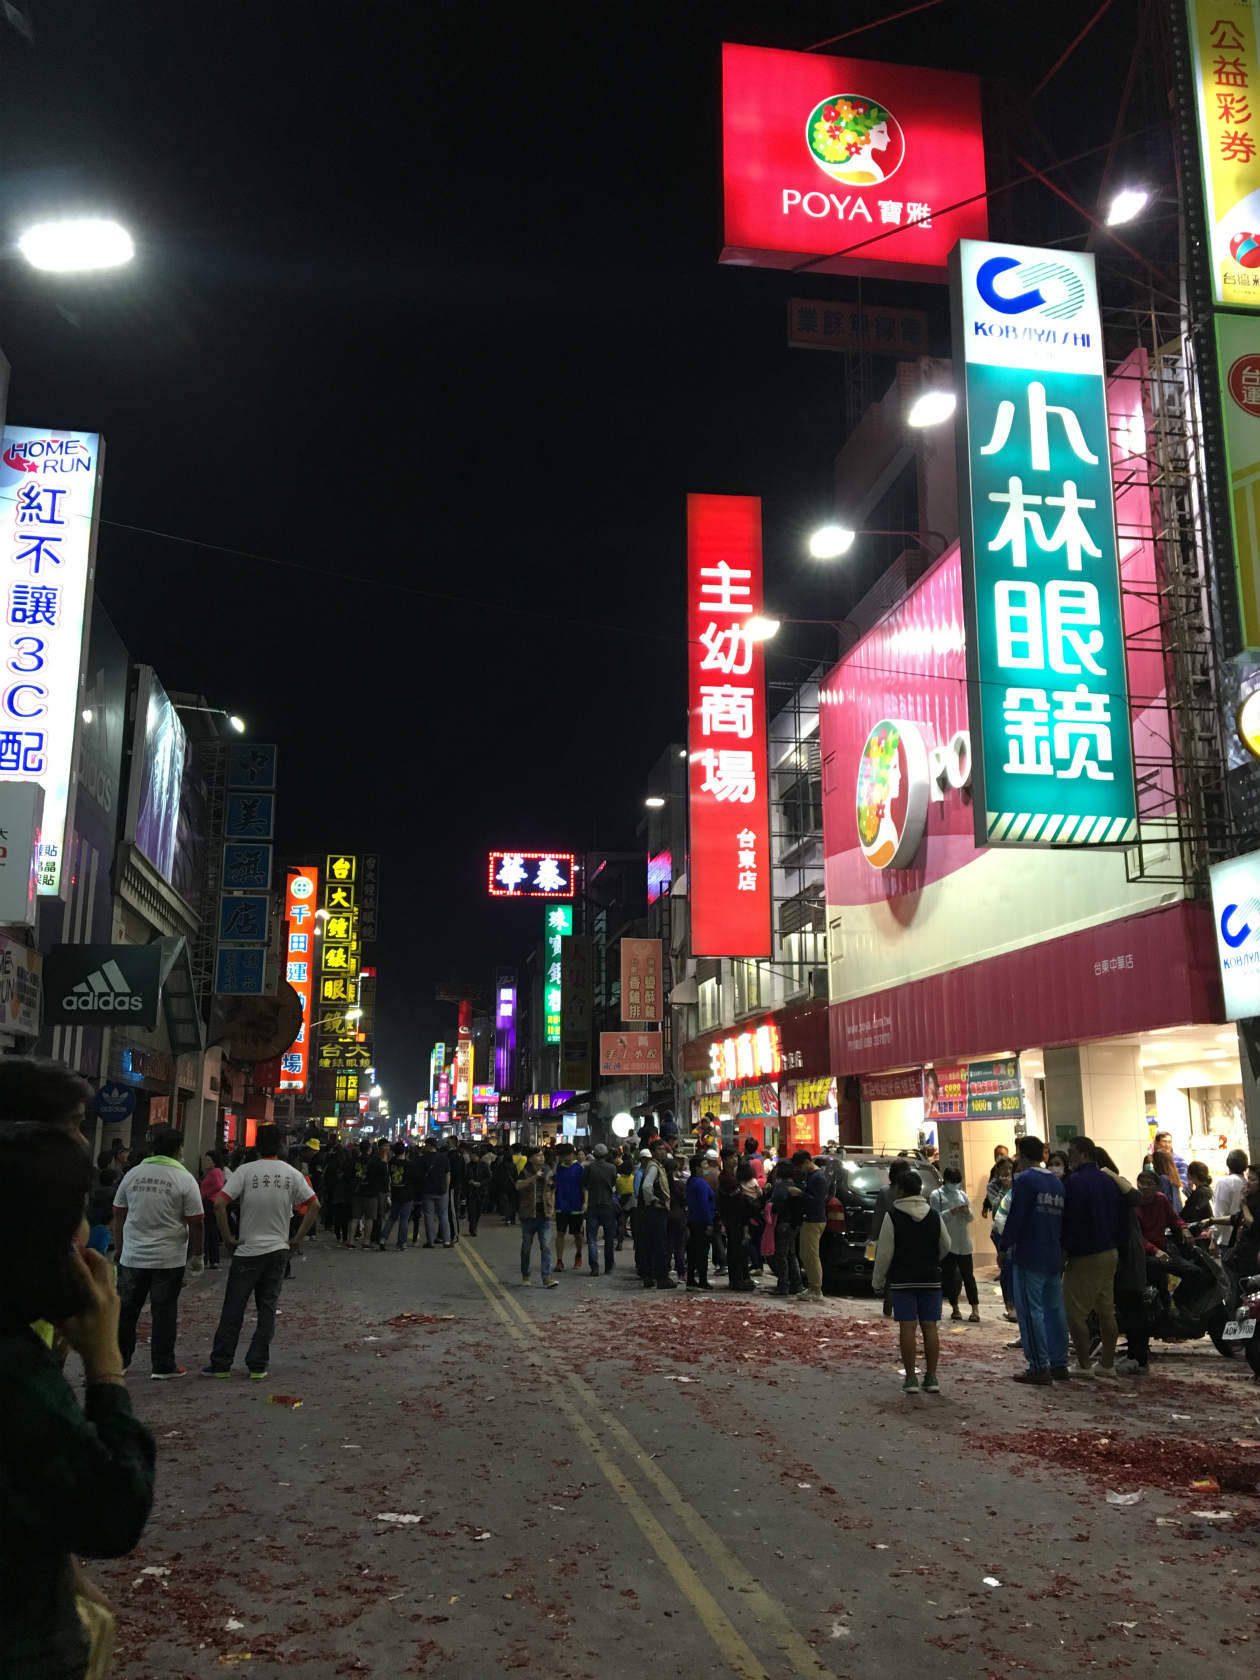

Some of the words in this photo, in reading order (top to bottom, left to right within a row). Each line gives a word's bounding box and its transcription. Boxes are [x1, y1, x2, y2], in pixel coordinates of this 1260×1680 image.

[1209, 19, 1257, 165] 公益彩券
[782, 188, 873, 223] POYA
[878, 199, 933, 228] 寶雅
[973, 320, 1091, 348] KOBAYASHI
[10, 439, 80, 459] HOME
[43, 457, 91, 474] RUN
[979, 381, 1114, 781] 小林眼鏡
[698, 561, 757, 804] 主幼商場
[736, 828, 757, 892] 台東店
[1093, 954, 1134, 976] 台東中華店
[62, 991, 143, 1011] adidas
[319, 1043, 372, 1058] 台大
